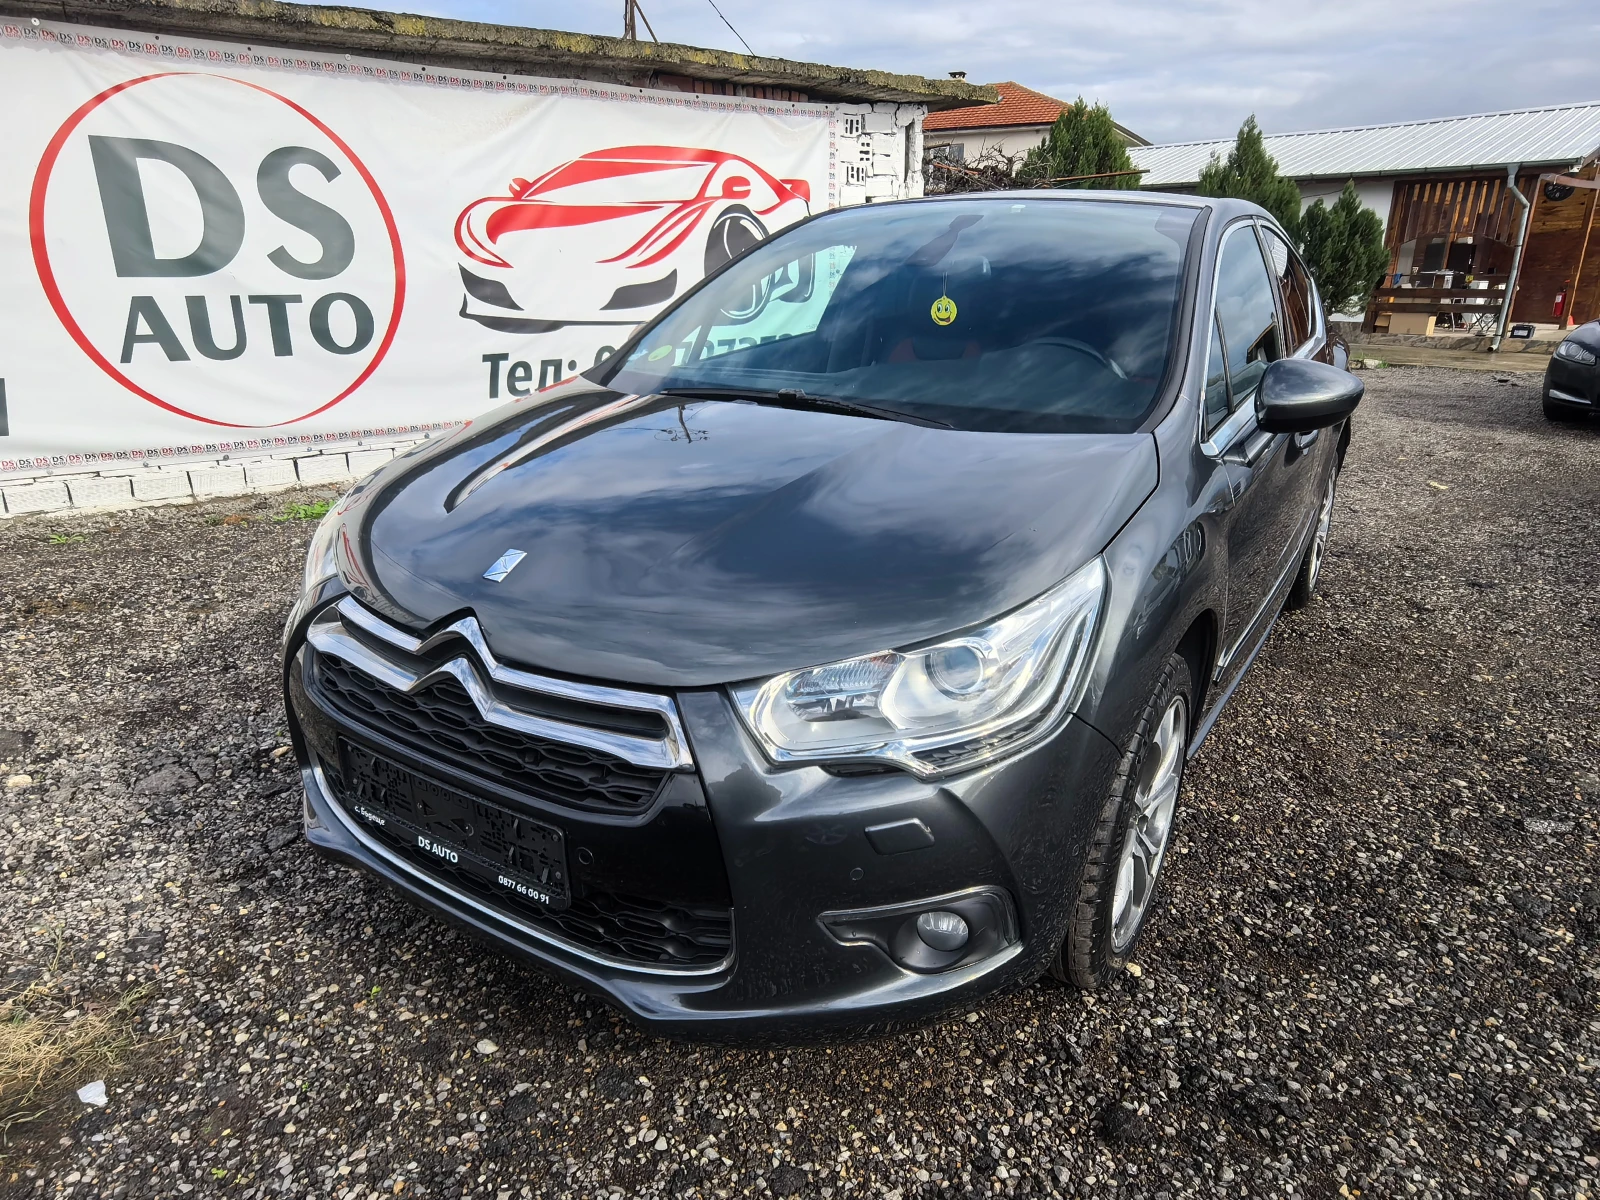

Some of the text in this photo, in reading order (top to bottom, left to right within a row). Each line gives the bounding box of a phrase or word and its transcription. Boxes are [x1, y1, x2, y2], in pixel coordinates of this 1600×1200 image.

[88, 135, 355, 280] DS
[120, 292, 375, 363] AUTO
[418, 836, 458, 862] DS AUTO
[498, 875, 549, 904] 0877 66 00 91
